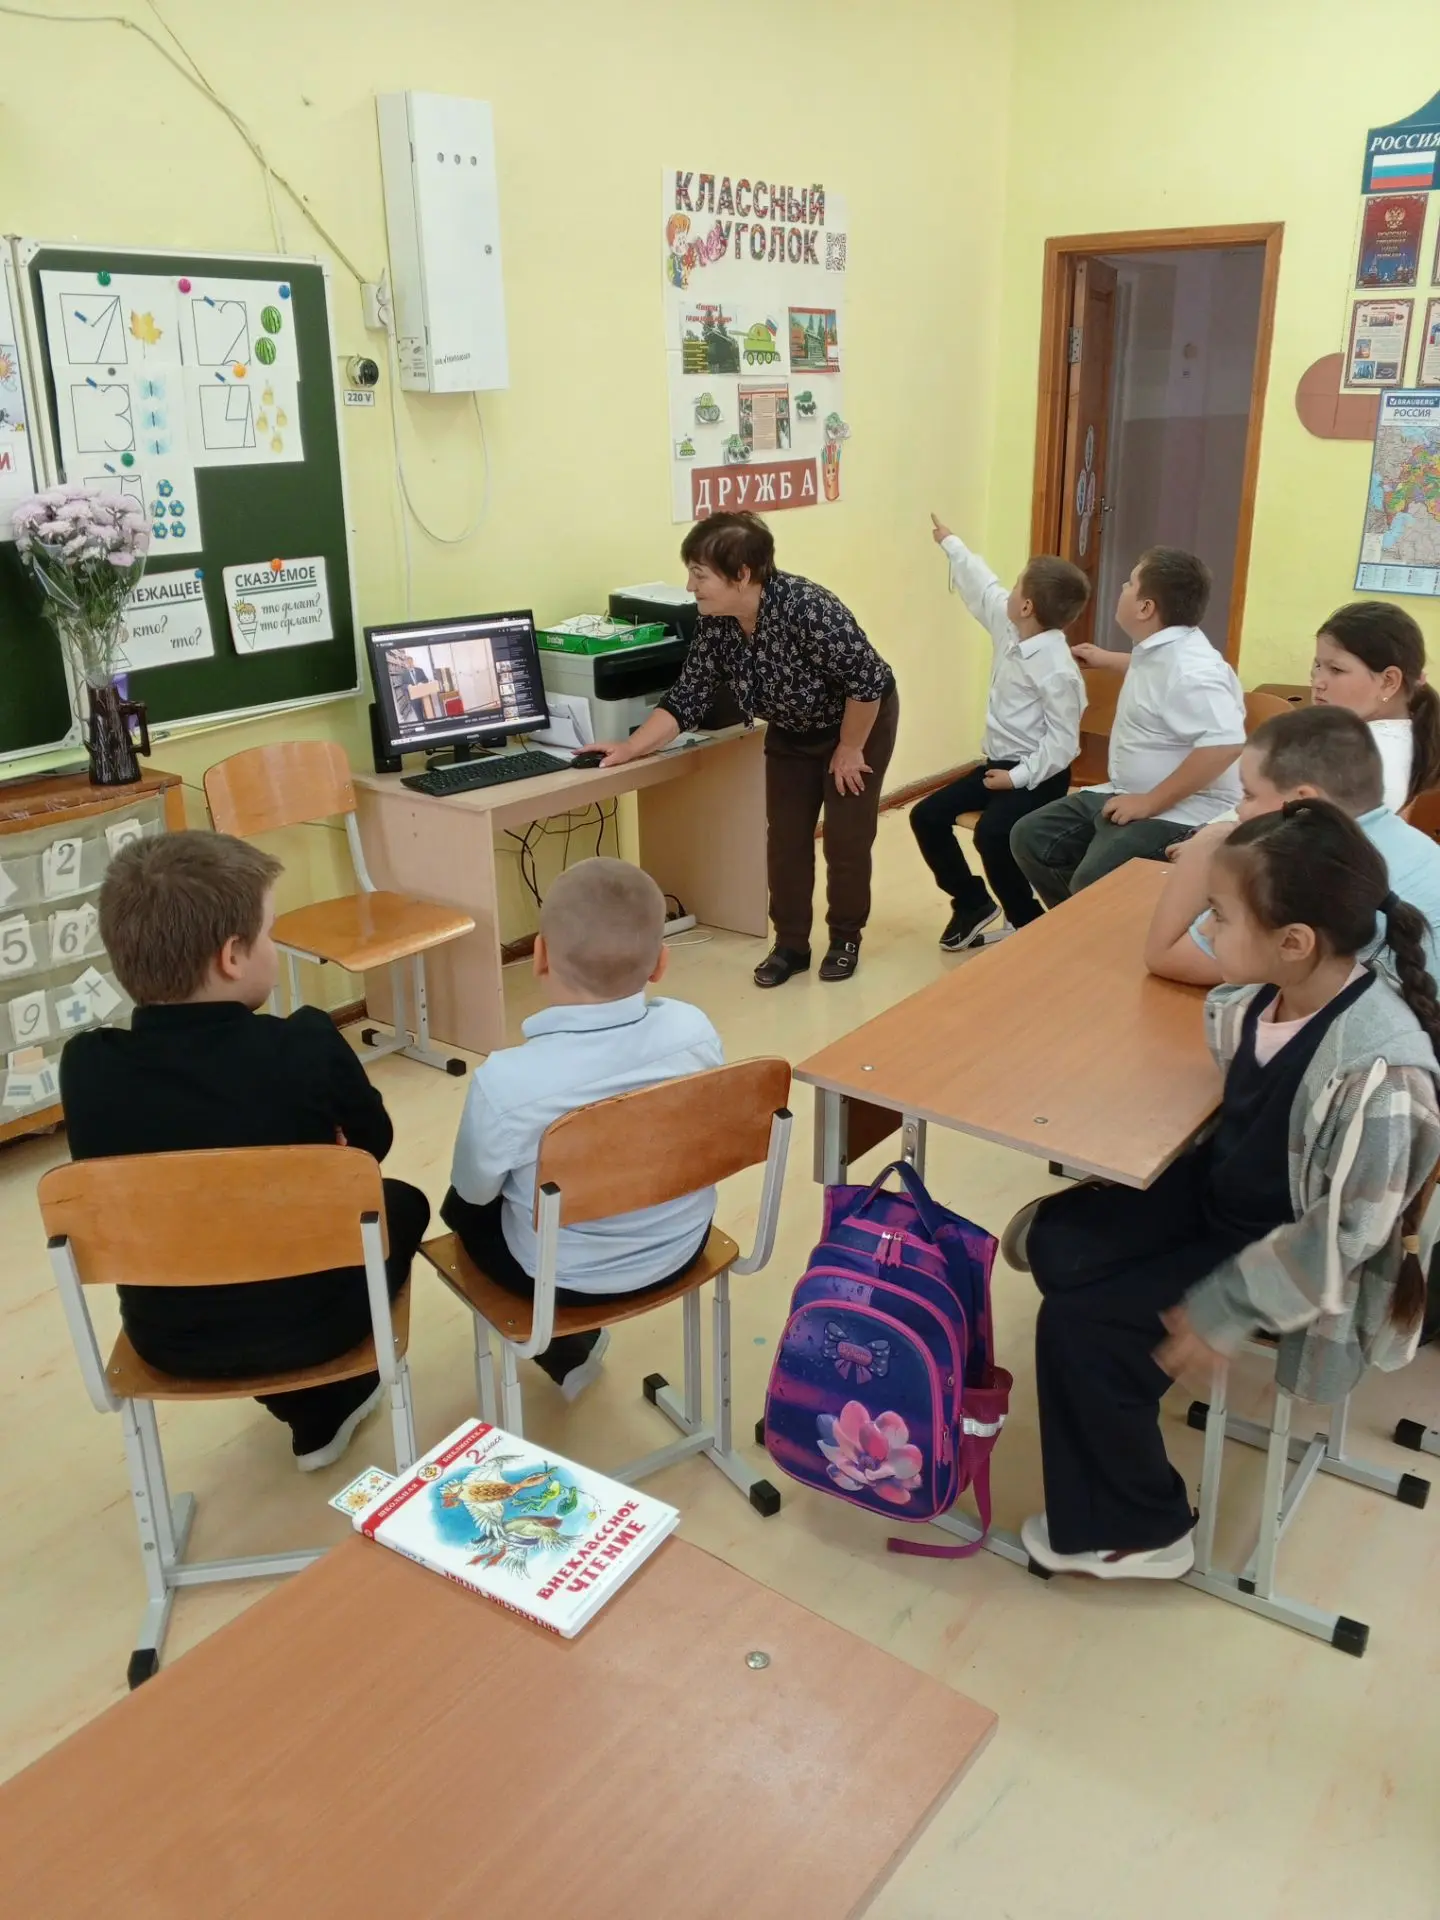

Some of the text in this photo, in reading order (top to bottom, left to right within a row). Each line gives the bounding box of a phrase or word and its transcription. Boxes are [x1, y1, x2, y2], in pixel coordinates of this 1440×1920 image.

[675, 170, 826, 226] КЛАССНЫЙ
[713, 220, 820, 265] УГОЛОК
[347, 392, 372, 402] 220 V
[1393, 408, 1431, 418] РОССИЯ
[695, 468, 816, 516] ДРУЖБА
[130, 580, 202, 604] ЕЖАЩЕЕ
[235, 566, 317, 588] СКАЗУЕМОЕ
[259, 607, 323, 636] что сделает?
[261, 591, 321, 620] что делает?
[132, 614, 168, 638] кто?
[170, 627, 202, 649] что?
[56, 843, 76, 876] 2
[2, 927, 28, 966] 5
[59, 921, 78, 954] 6
[19, 1003, 40, 1036] 9
[466, 1448, 487, 1464] 2
[377, 1482, 419, 1519] ШКОЛЬНАЯ
[536, 1499, 640, 1601] ВНЕКЛАССНОЕ
[566, 1519, 647, 1594] ЧТЕНИЕ
